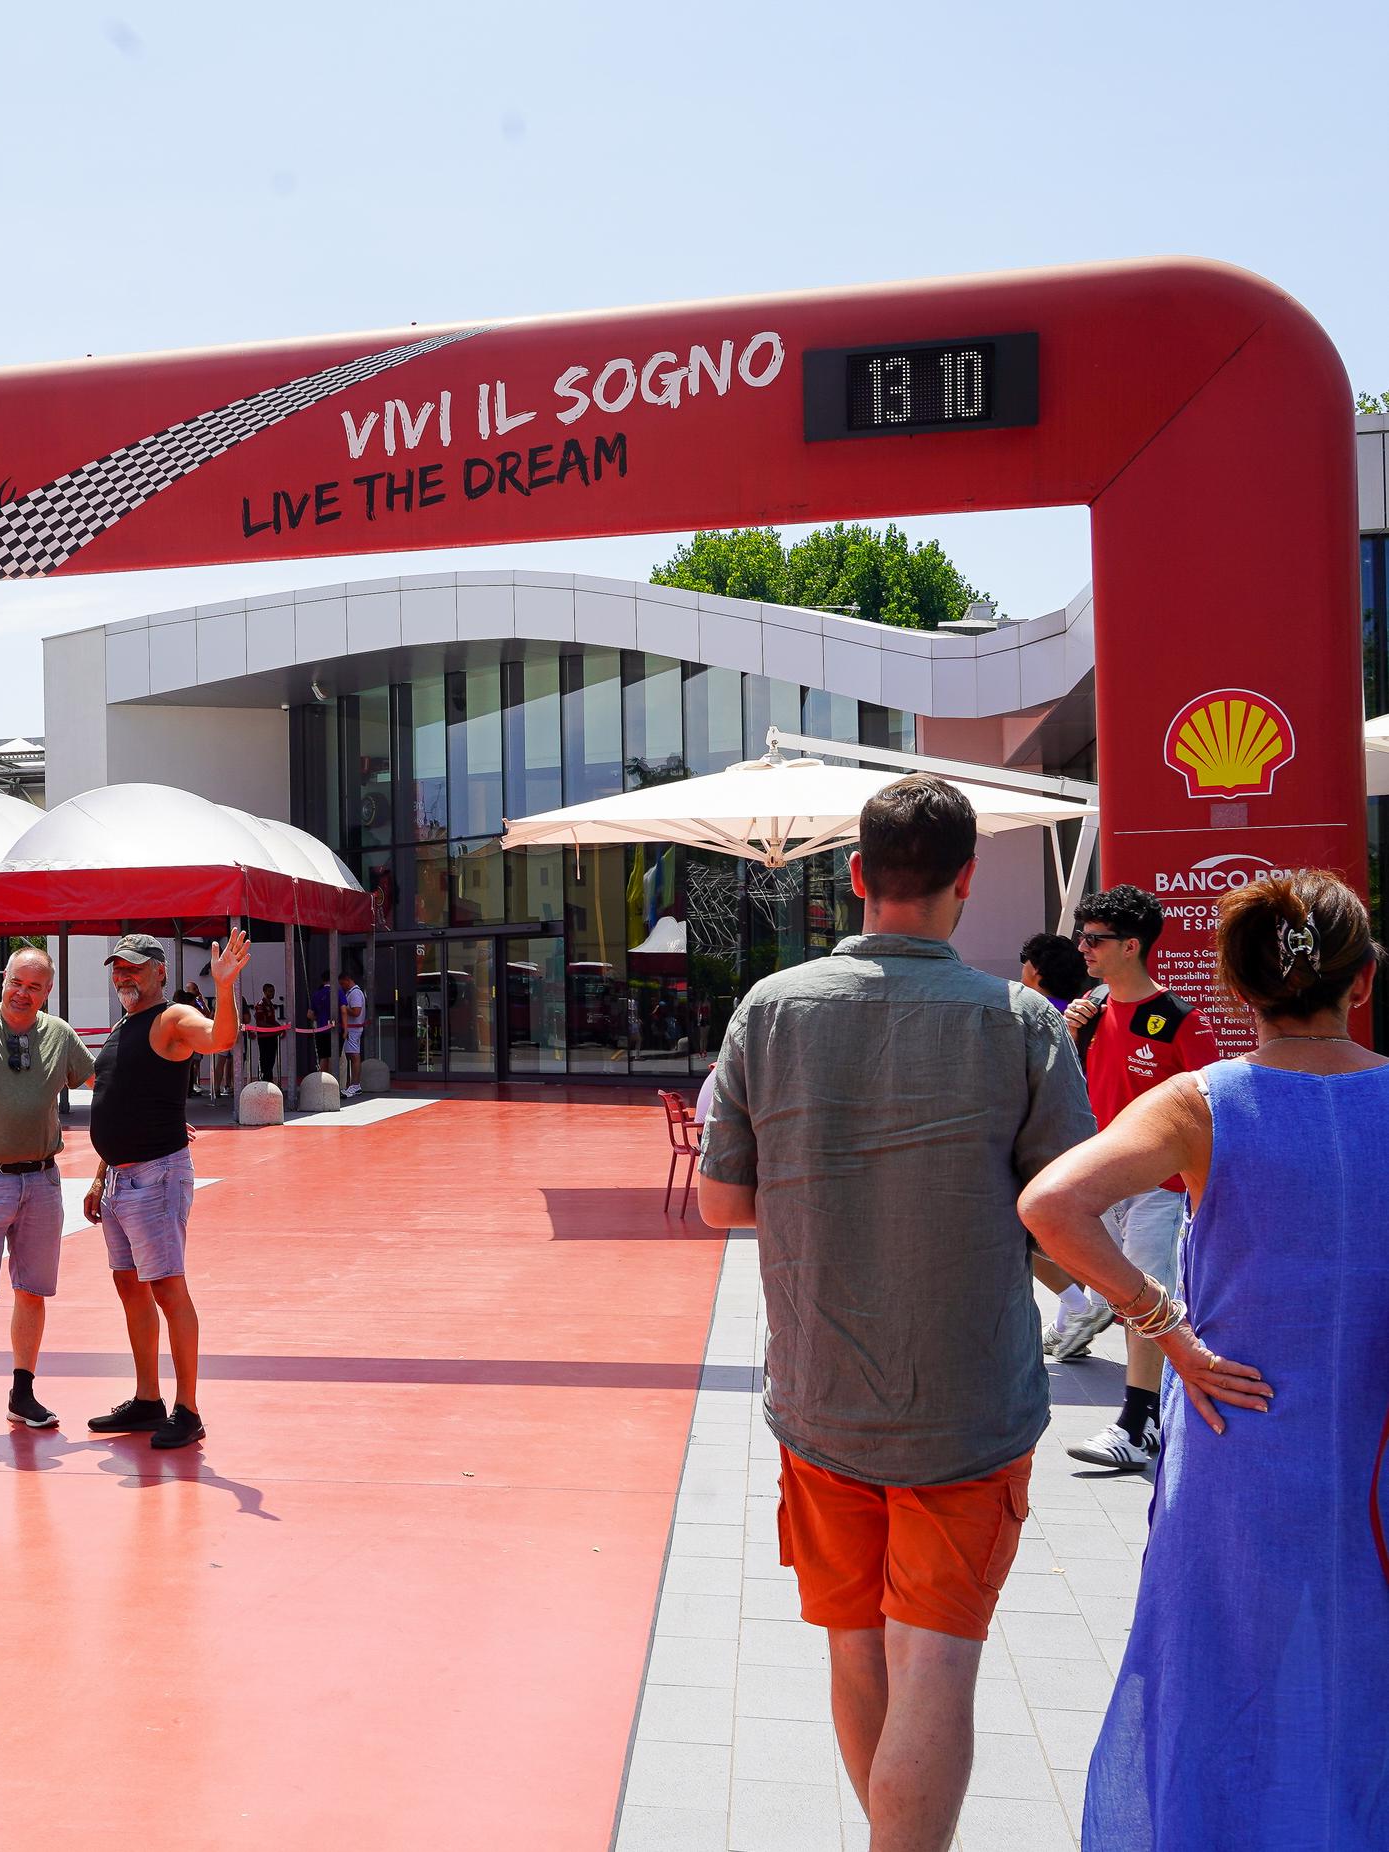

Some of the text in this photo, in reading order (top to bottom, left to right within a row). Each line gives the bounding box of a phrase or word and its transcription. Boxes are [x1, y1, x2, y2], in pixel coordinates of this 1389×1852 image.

[869, 351, 982, 424] 13 10
[341, 331, 785, 458] VIVI IL SOGNO
[242, 432, 627, 538] LIVE THE DREAM
[1155, 870, 1248, 892] BANCO
[1162, 905, 1207, 917] ANCO
[1183, 919, 1191, 930] E
[1165, 950, 1191, 958] Banco
[1157, 960, 1219, 969] nel 1930 died
[1157, 972, 1166, 980] la
[1169, 971, 1210, 982] possibilità
[1169, 983, 1202, 991] fondare
[1213, 1015, 1221, 1024] la
[1221, 1027, 1247, 1035] Banco
[1215, 1038, 1253, 1047] lavorano
